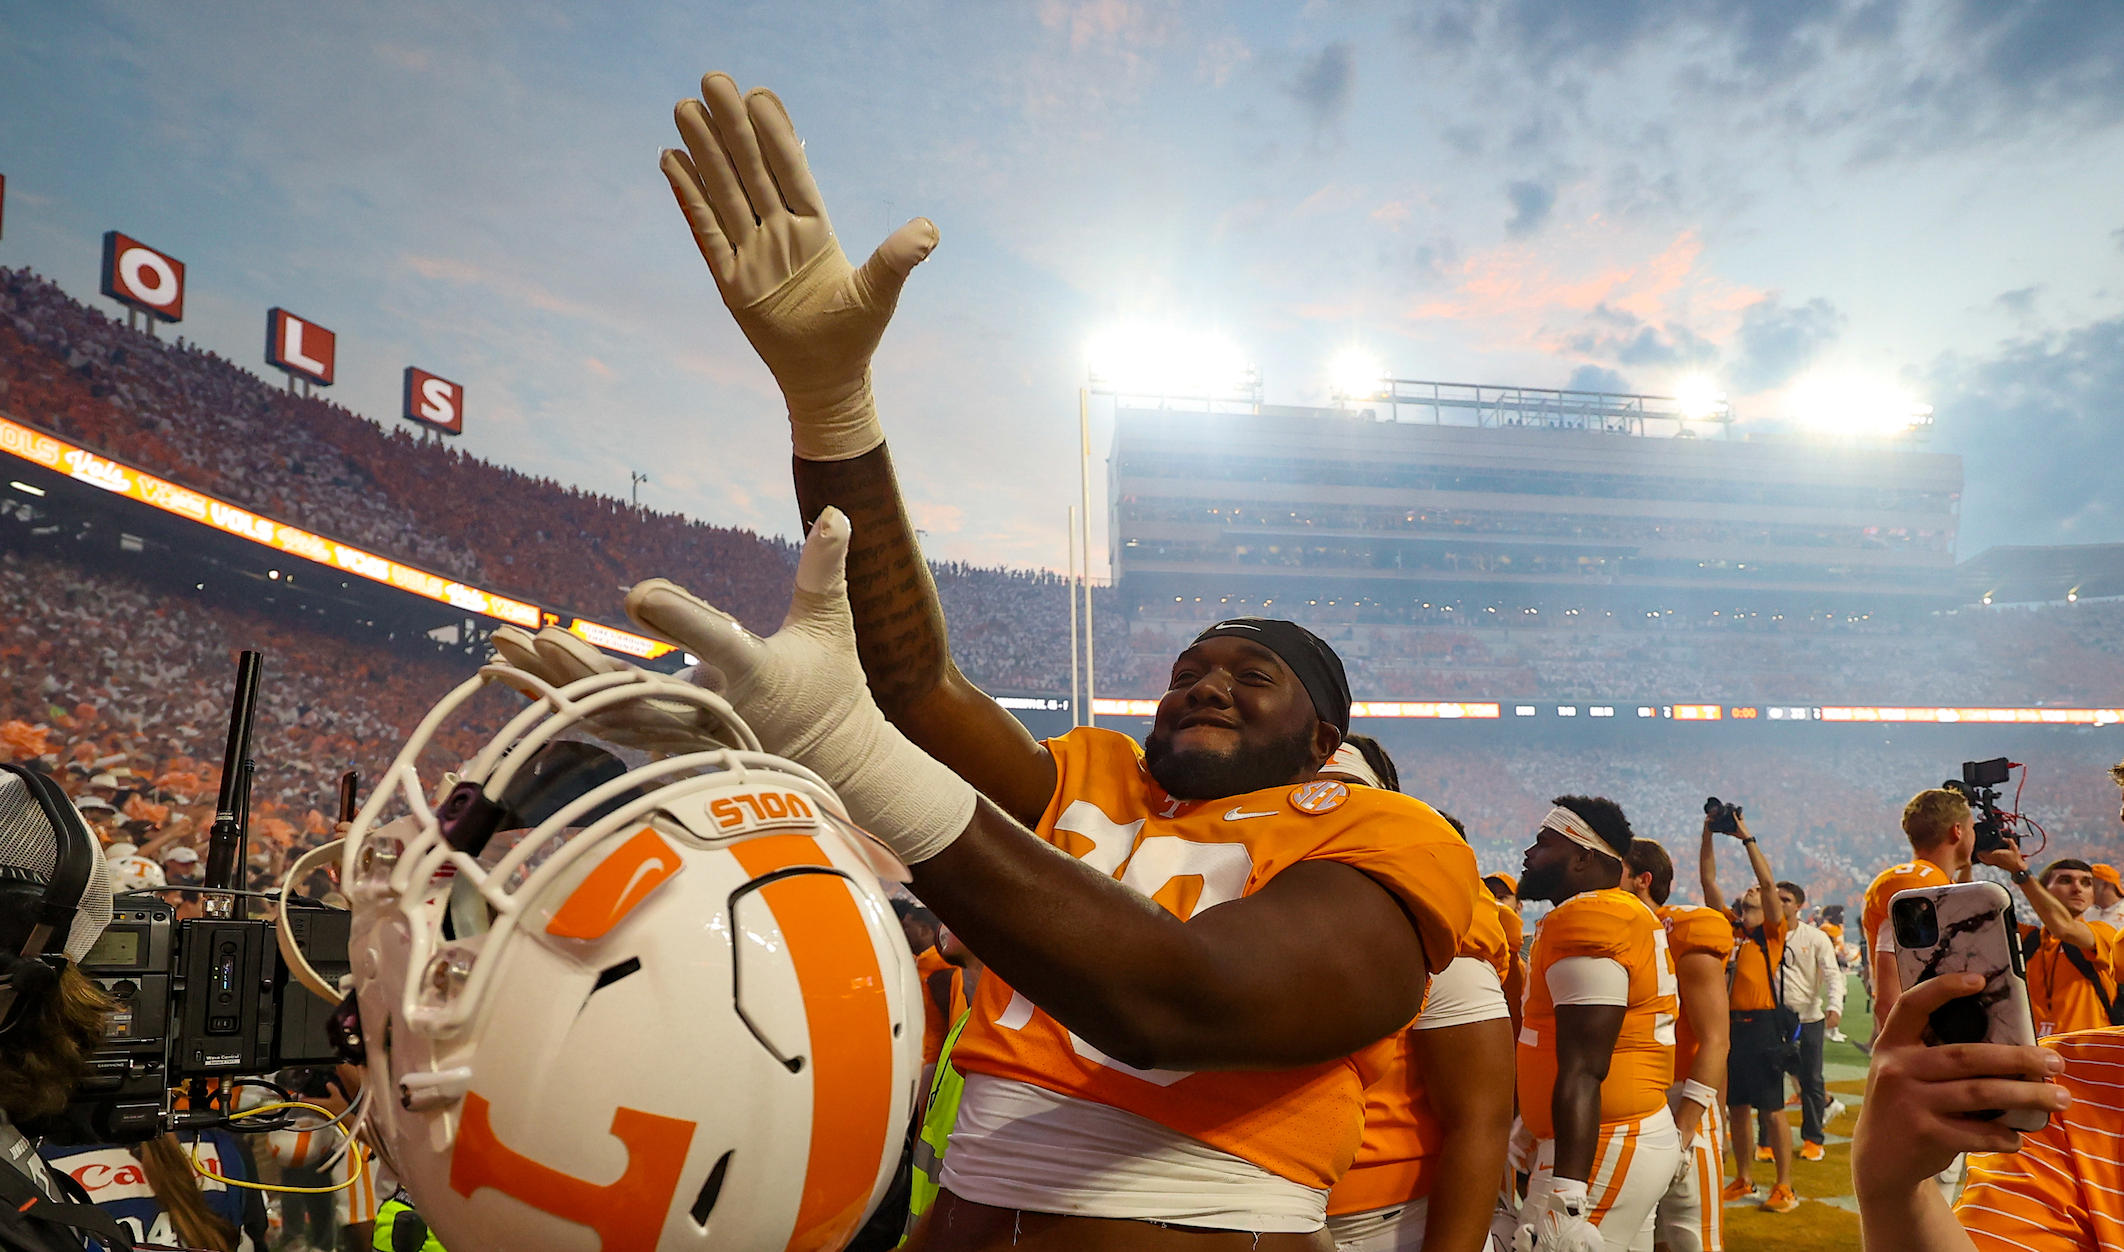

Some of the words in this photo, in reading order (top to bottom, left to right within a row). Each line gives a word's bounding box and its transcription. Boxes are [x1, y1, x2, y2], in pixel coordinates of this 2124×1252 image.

[119, 247, 178, 306] O
[284, 316, 325, 375] L
[420, 378, 454, 424] S
[65, 449, 132, 492] Vols
[210, 503, 273, 543] VOLS
[392, 564, 443, 598] VOLS
[1731, 707, 1757, 719] 0:00
[710, 792, 813, 828] VOLS
[1293, 782, 1347, 811] SEC
[131, 860, 153, 877] T
